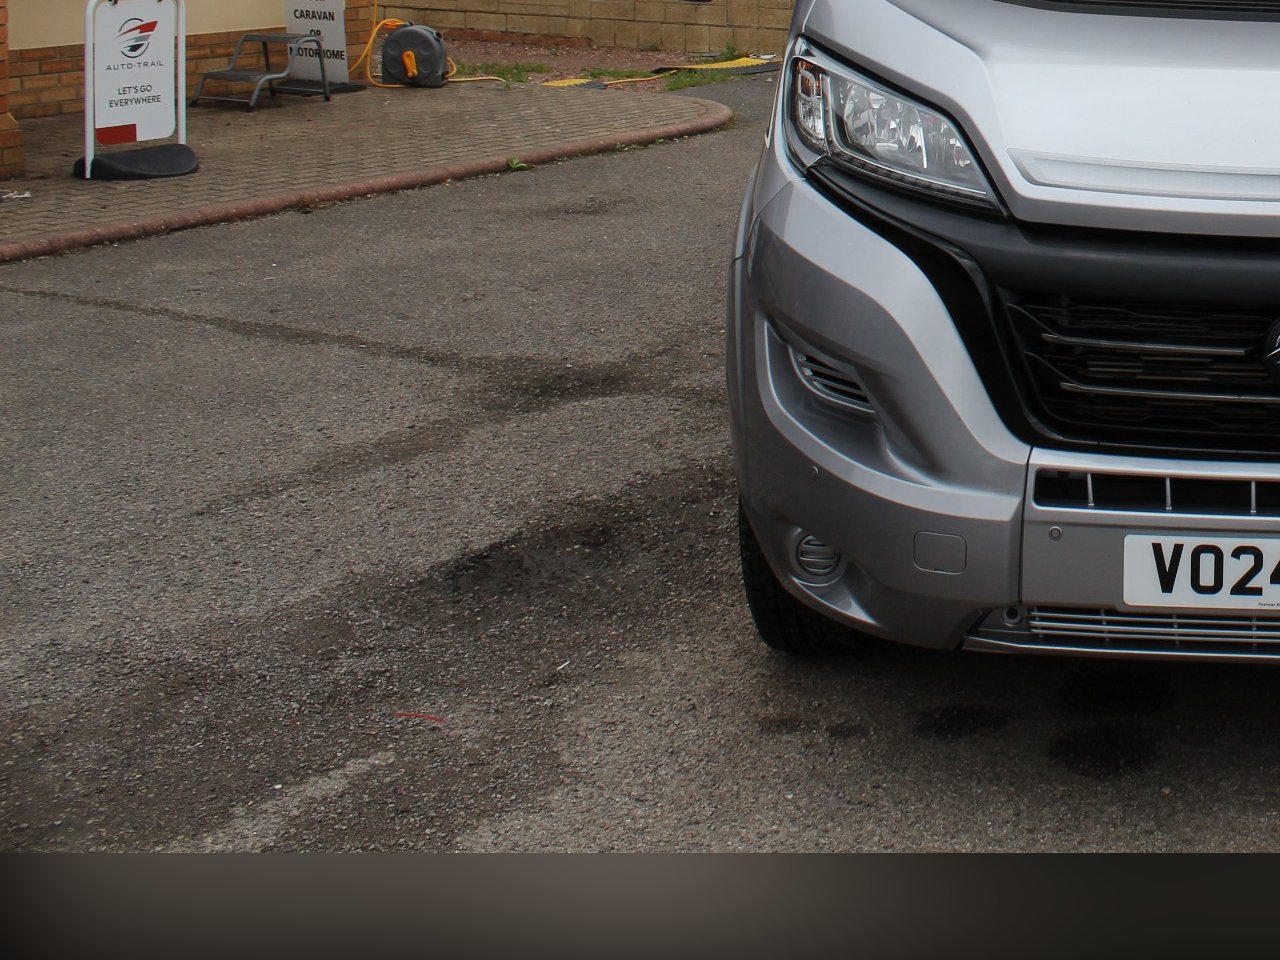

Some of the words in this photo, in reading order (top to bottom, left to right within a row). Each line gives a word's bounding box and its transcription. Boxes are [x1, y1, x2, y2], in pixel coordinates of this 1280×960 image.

[293, 9, 335, 21] CARAVAN
[106, 61, 164, 71] AUTO-TRAIL
[118, 85, 139, 96] LET'S
[140, 84, 153, 93] GO
[109, 95, 161, 108] EVERYWHERE
